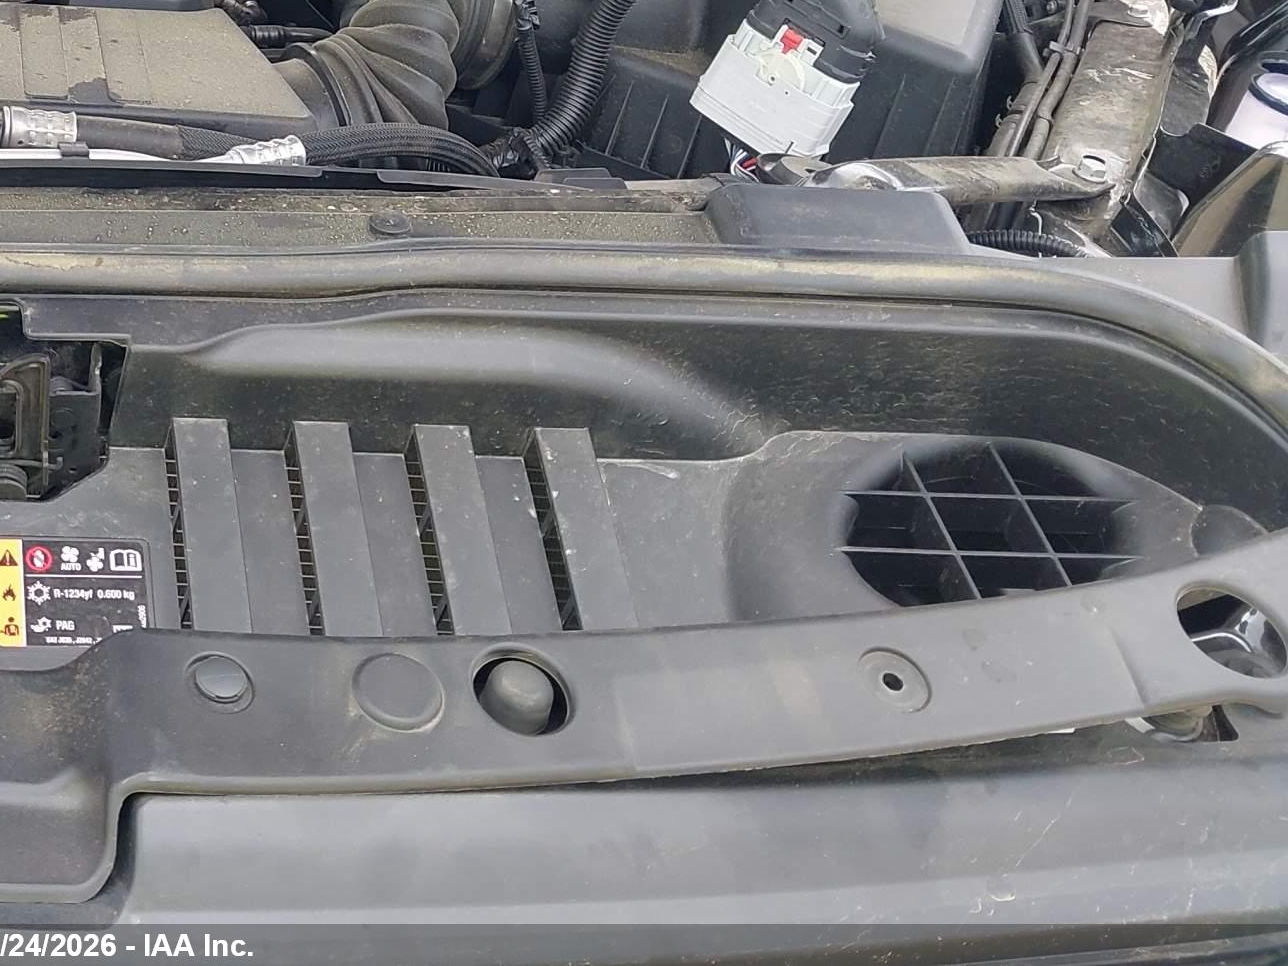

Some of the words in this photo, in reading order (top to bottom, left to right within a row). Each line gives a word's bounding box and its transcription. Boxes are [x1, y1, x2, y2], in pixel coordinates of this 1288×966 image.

[61, 562, 82, 571] AUTO
[53, 588, 93, 601] R-1234yf
[97, 589, 122, 599] 0.600
[123, 590, 135, 601] kg
[56, 620, 75, 631] PAG
